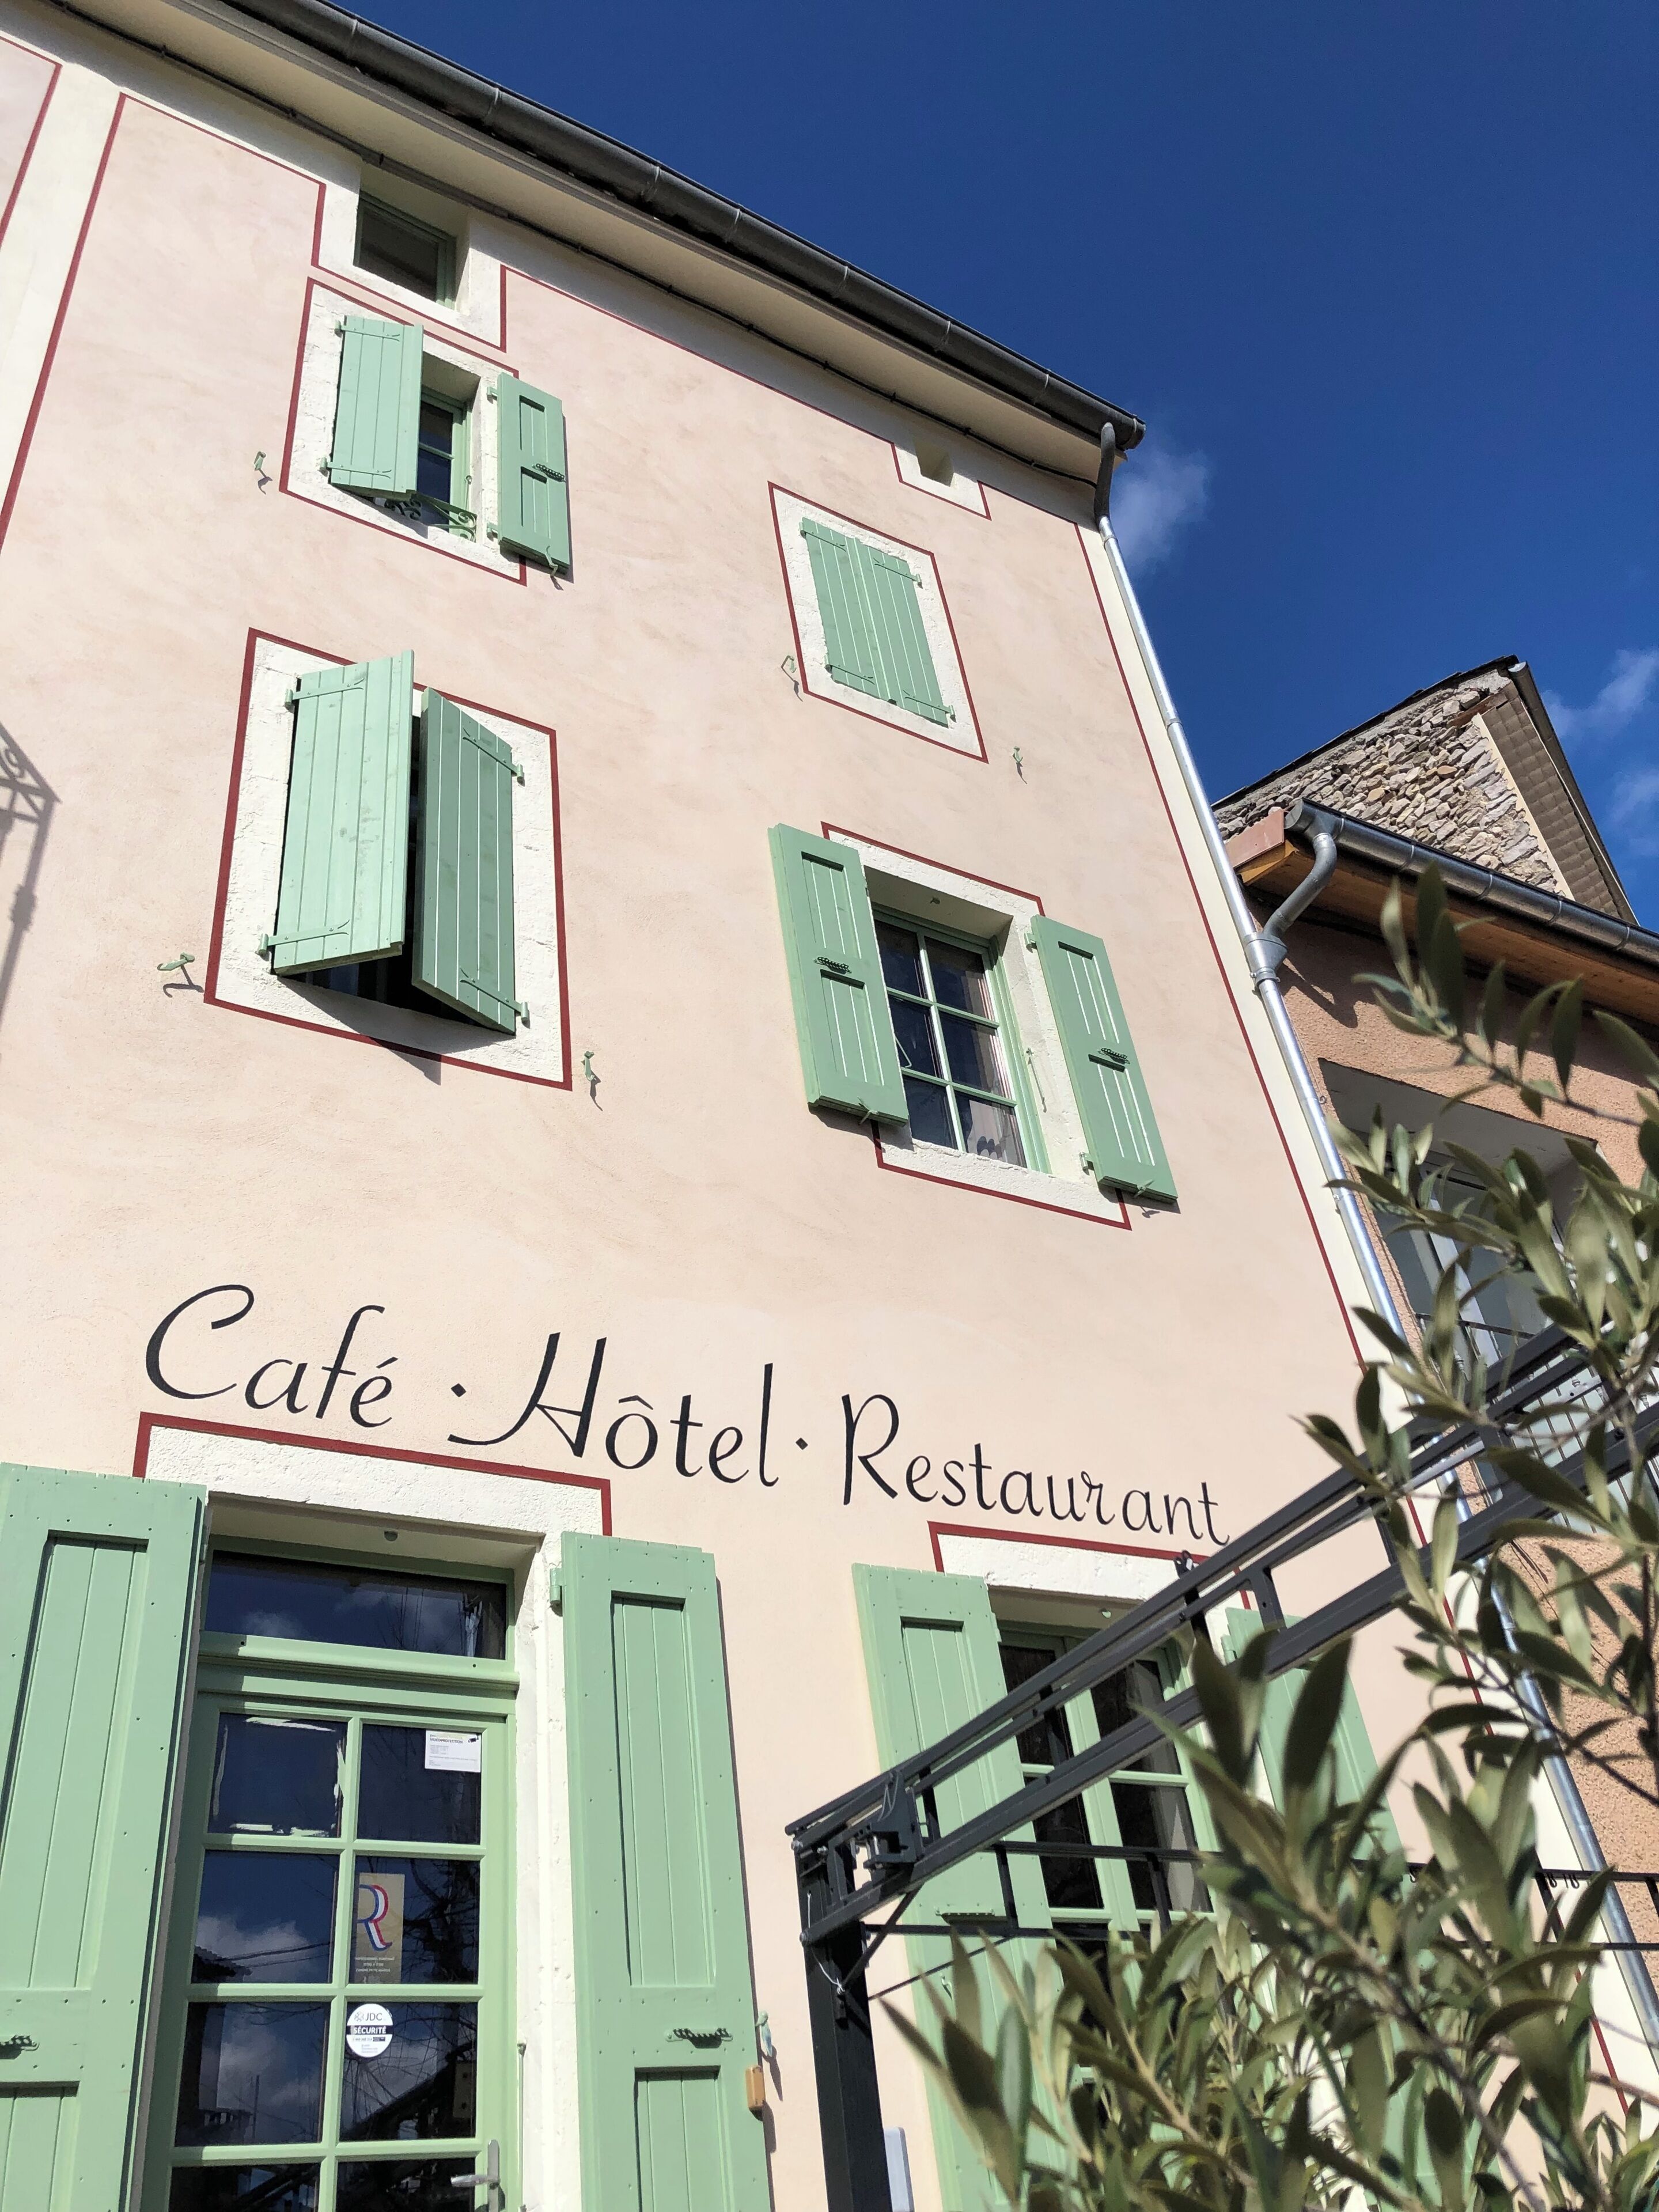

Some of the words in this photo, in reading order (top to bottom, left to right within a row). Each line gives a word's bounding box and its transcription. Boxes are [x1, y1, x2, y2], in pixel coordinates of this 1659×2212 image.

[145, 1284, 399, 1428] Café
[446, 1332, 779, 1487] Hôtel
[841, 1393, 1231, 1547] Restaurant
[365, 2013, 382, 2021] JDC
[353, 2025, 387, 2034] SÉCURITÉ
